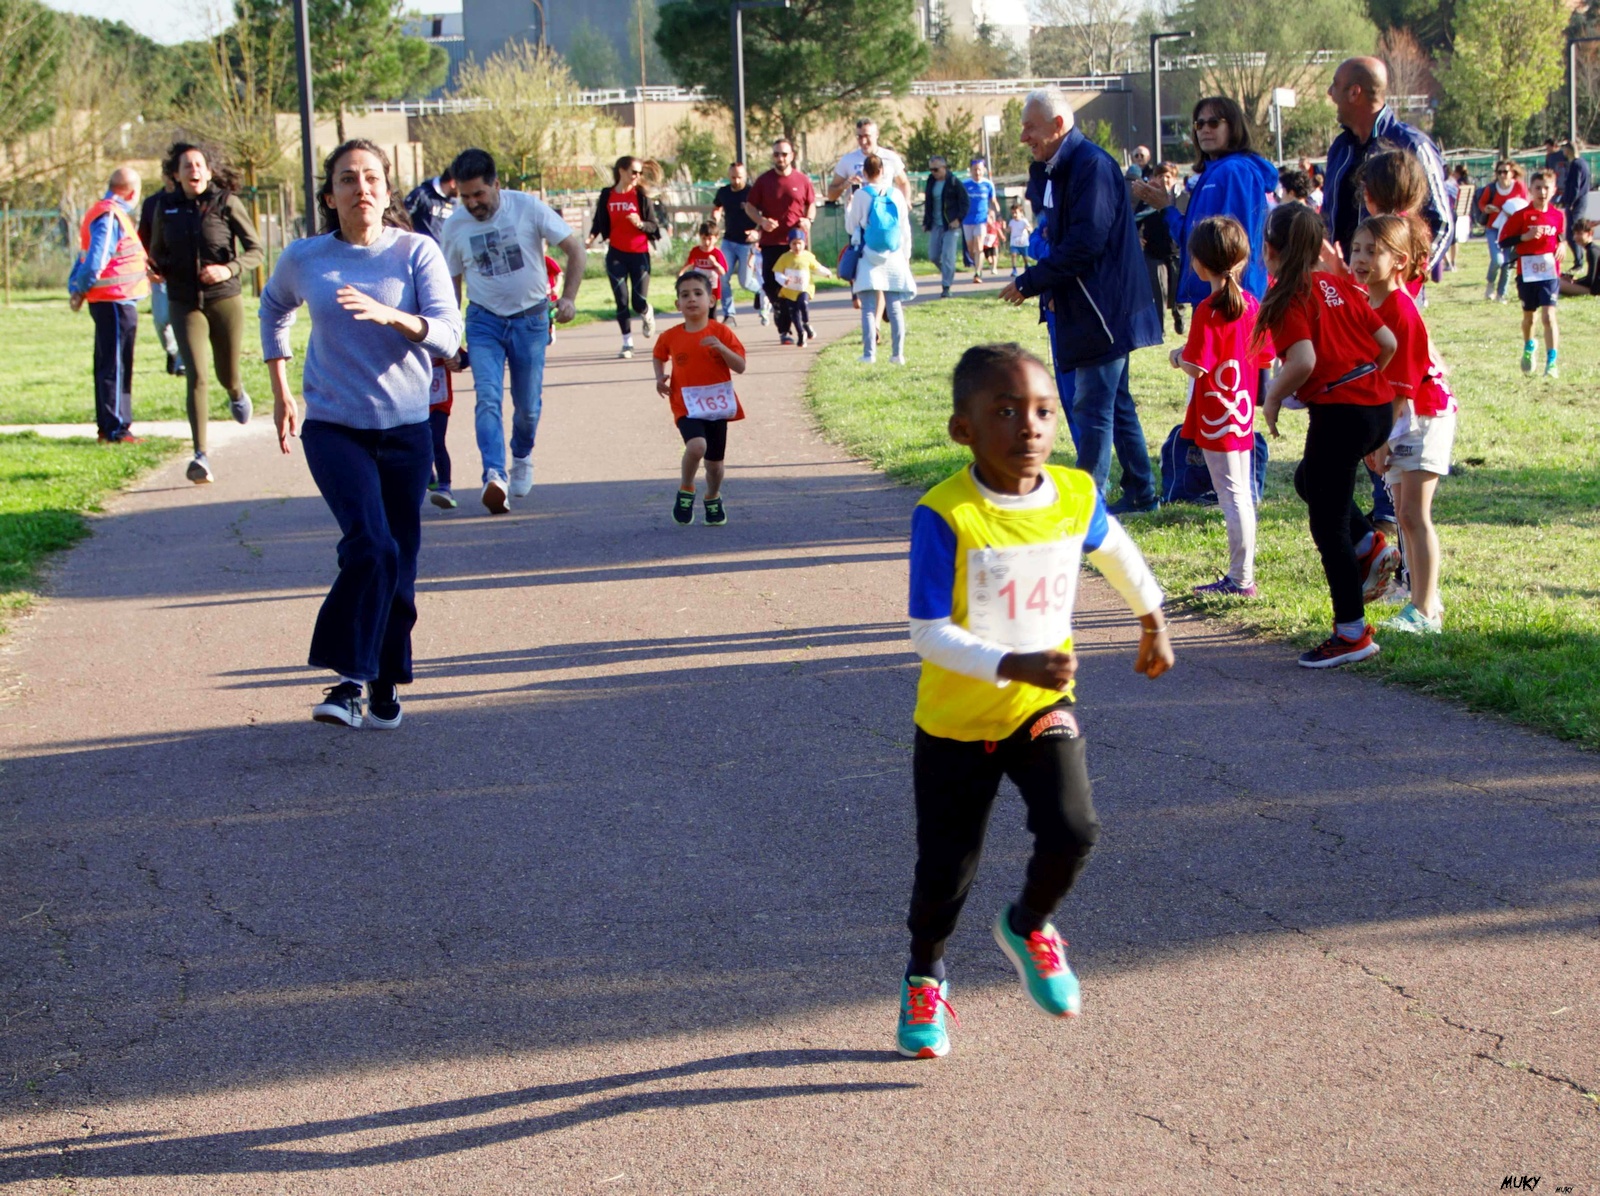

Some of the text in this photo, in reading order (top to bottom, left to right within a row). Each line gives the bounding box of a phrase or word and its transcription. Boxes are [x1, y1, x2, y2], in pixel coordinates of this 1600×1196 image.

[1532, 262, 1546, 273] 98
[695, 394, 729, 412] 163
[998, 573, 1068, 620] 149
